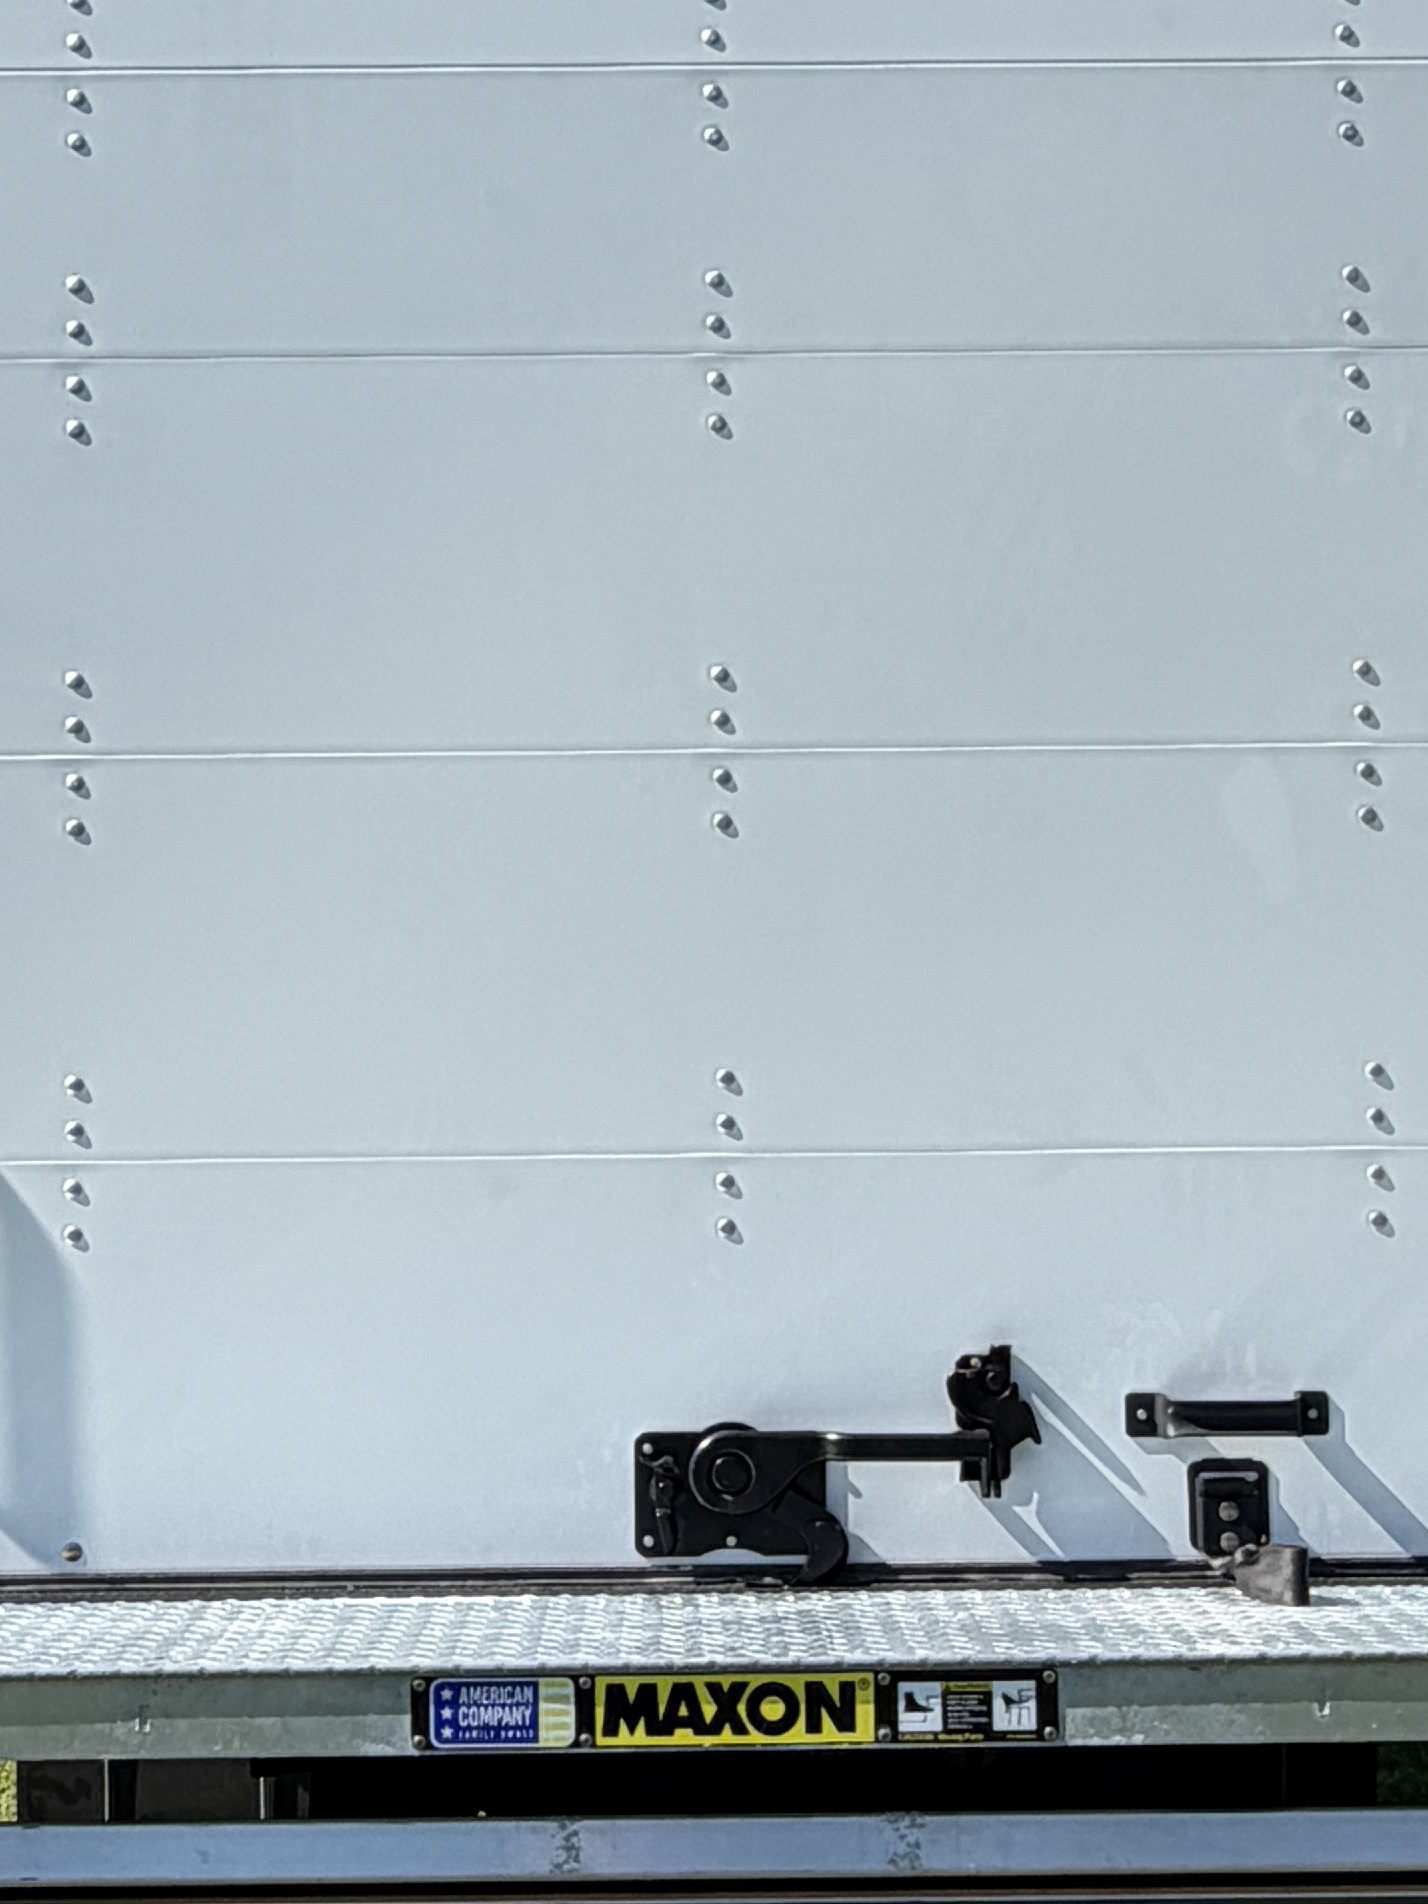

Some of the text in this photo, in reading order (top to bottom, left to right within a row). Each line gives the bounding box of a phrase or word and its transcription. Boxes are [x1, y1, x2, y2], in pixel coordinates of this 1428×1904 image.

[458, 1685, 534, 1704] AMERICAN
[458, 1705, 533, 1727] COMPANY
[601, 1680, 858, 1738] MAXON
